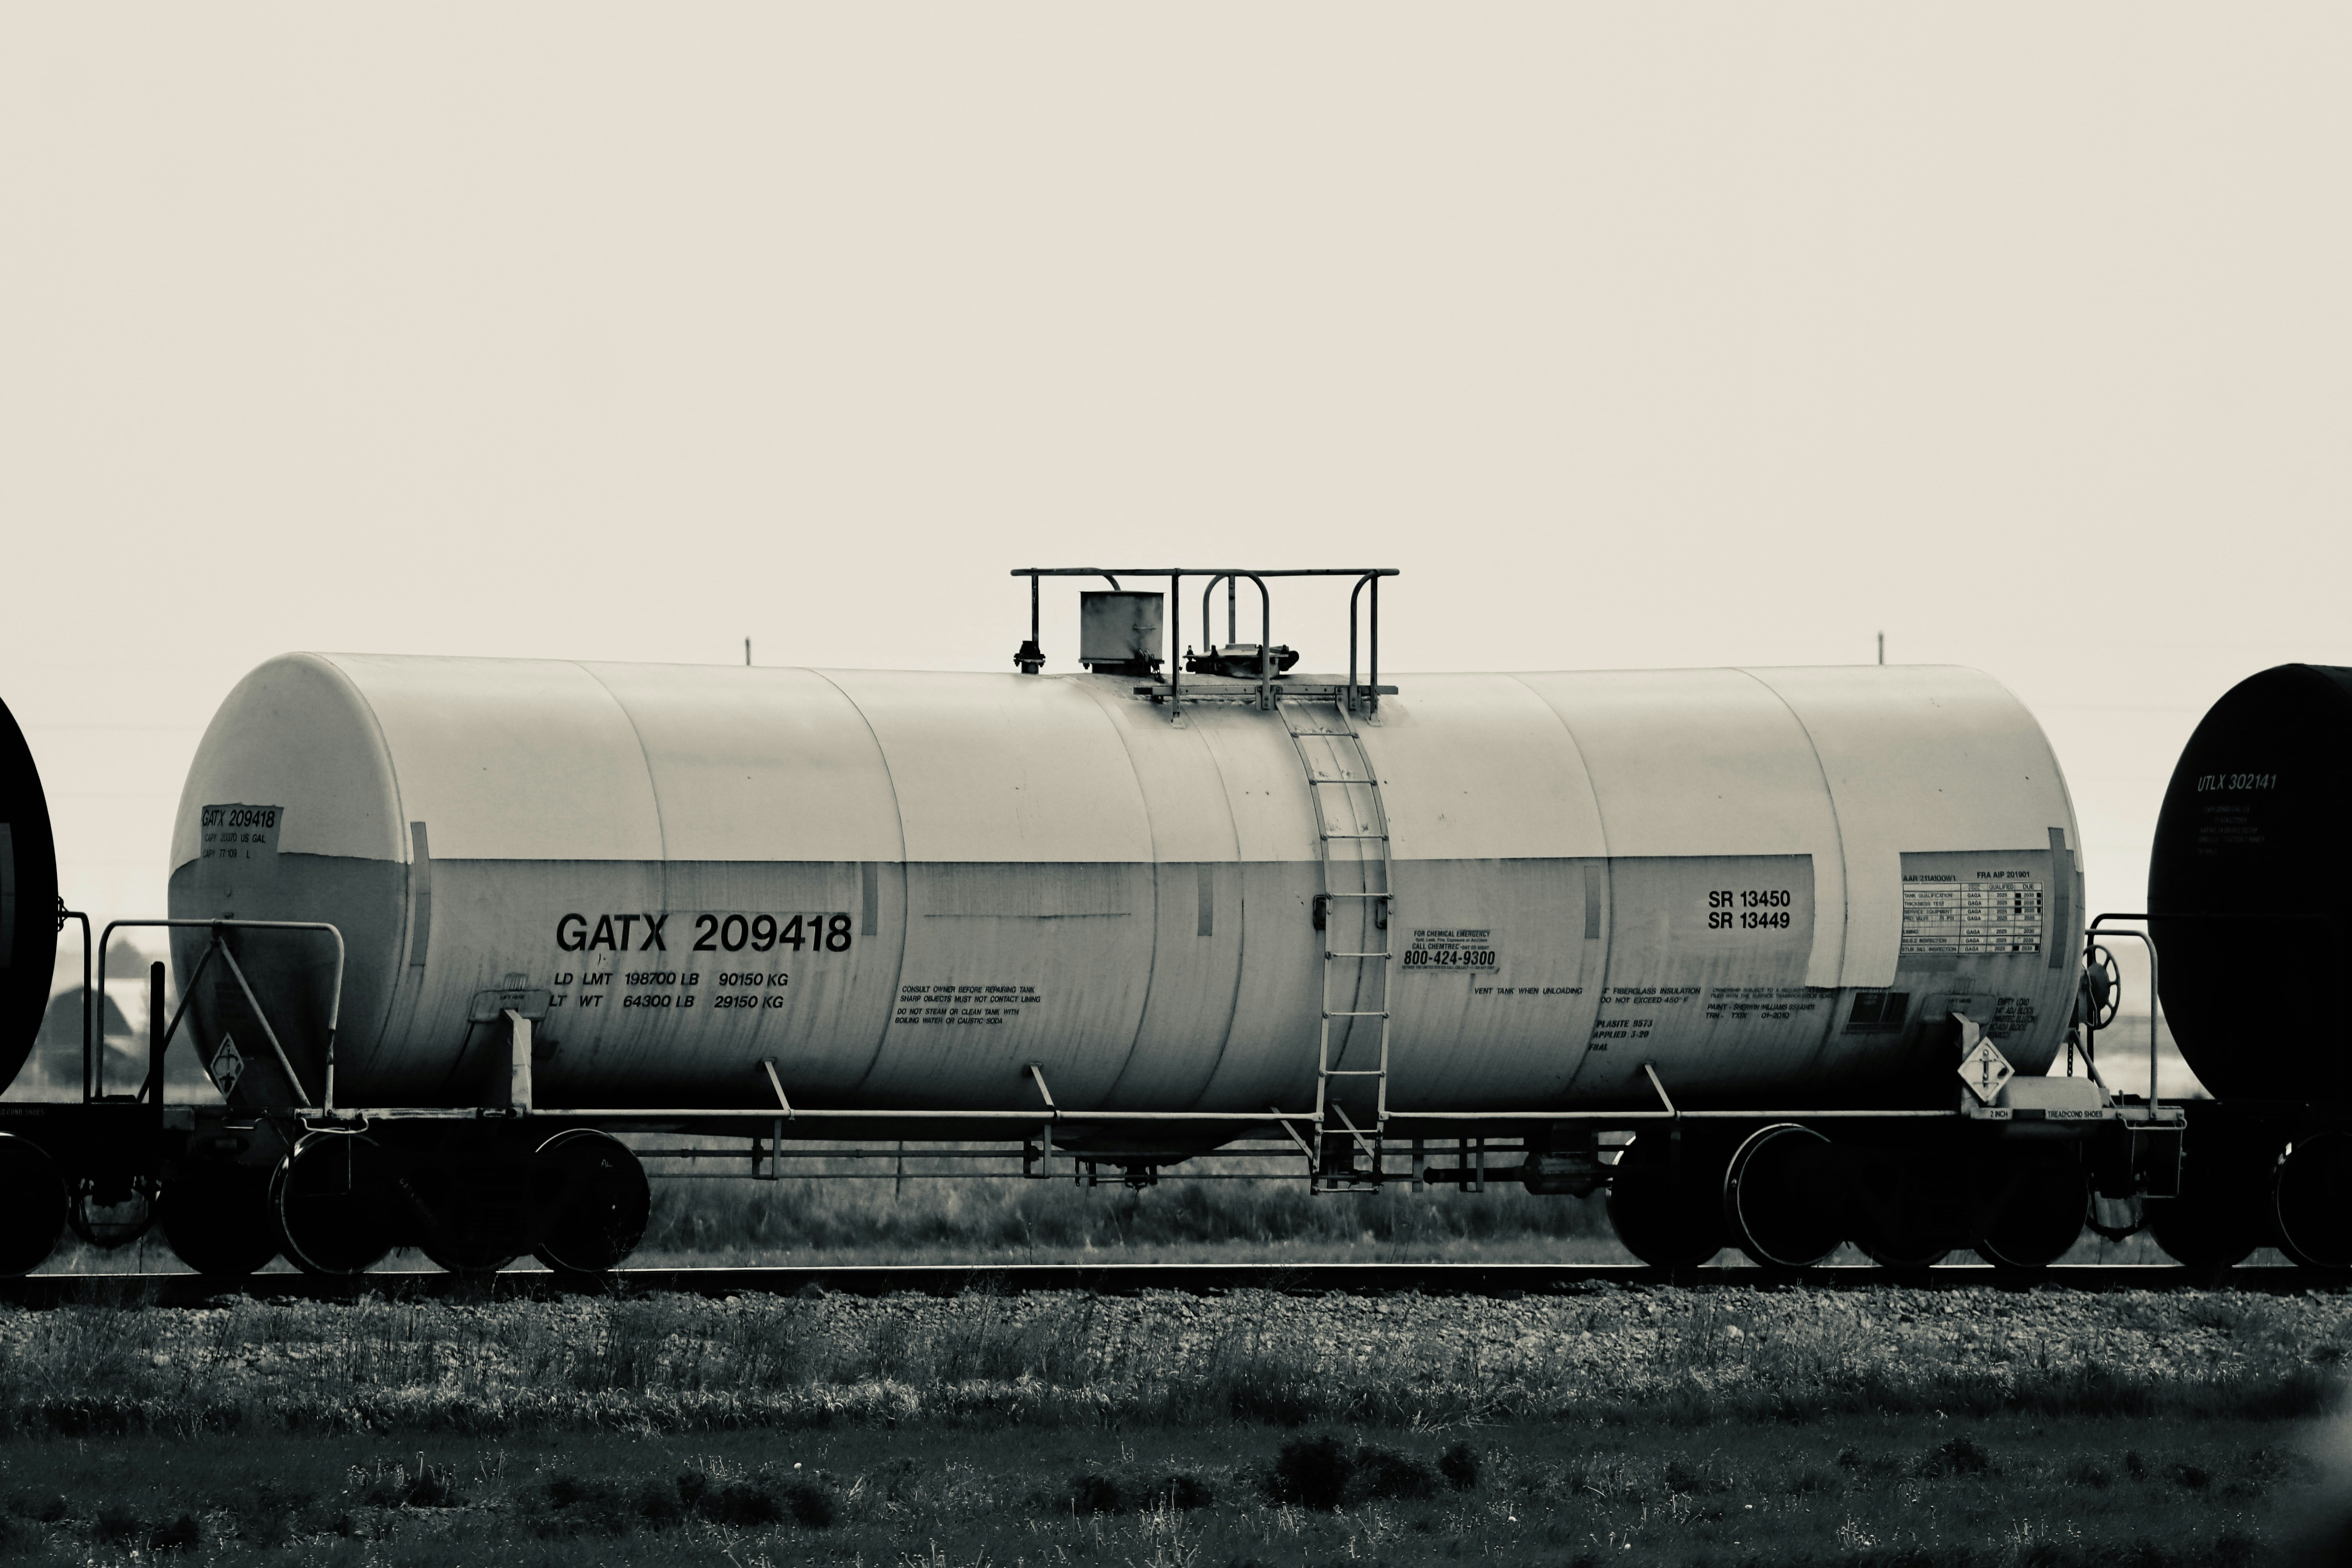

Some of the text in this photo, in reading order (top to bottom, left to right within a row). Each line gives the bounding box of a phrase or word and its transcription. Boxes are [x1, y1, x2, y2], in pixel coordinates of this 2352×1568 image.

[2198, 773, 2276, 791] UTLX 302141
[202, 809, 275, 828] GATX 209418
[205, 833, 216, 842] CAPY
[241, 834, 249, 842] US
[252, 834, 265, 843] GAL
[203, 849, 215, 858] CAPY
[228, 849, 237, 858] 109
[246, 850, 250, 858] L
[1708, 890, 1790, 907] SR 13450
[1708, 912, 1790, 929] SR 13449
[556, 913, 852, 952] GATX 209418
[1404, 950, 1495, 965] 800-424-9300
[554, 973, 789, 986] LD LMT 198700 LB 90150 KG
[549, 995, 784, 1008] LT WT 64300 LB 29150 KG
[1997, 997, 2014, 1006] EMPTY
